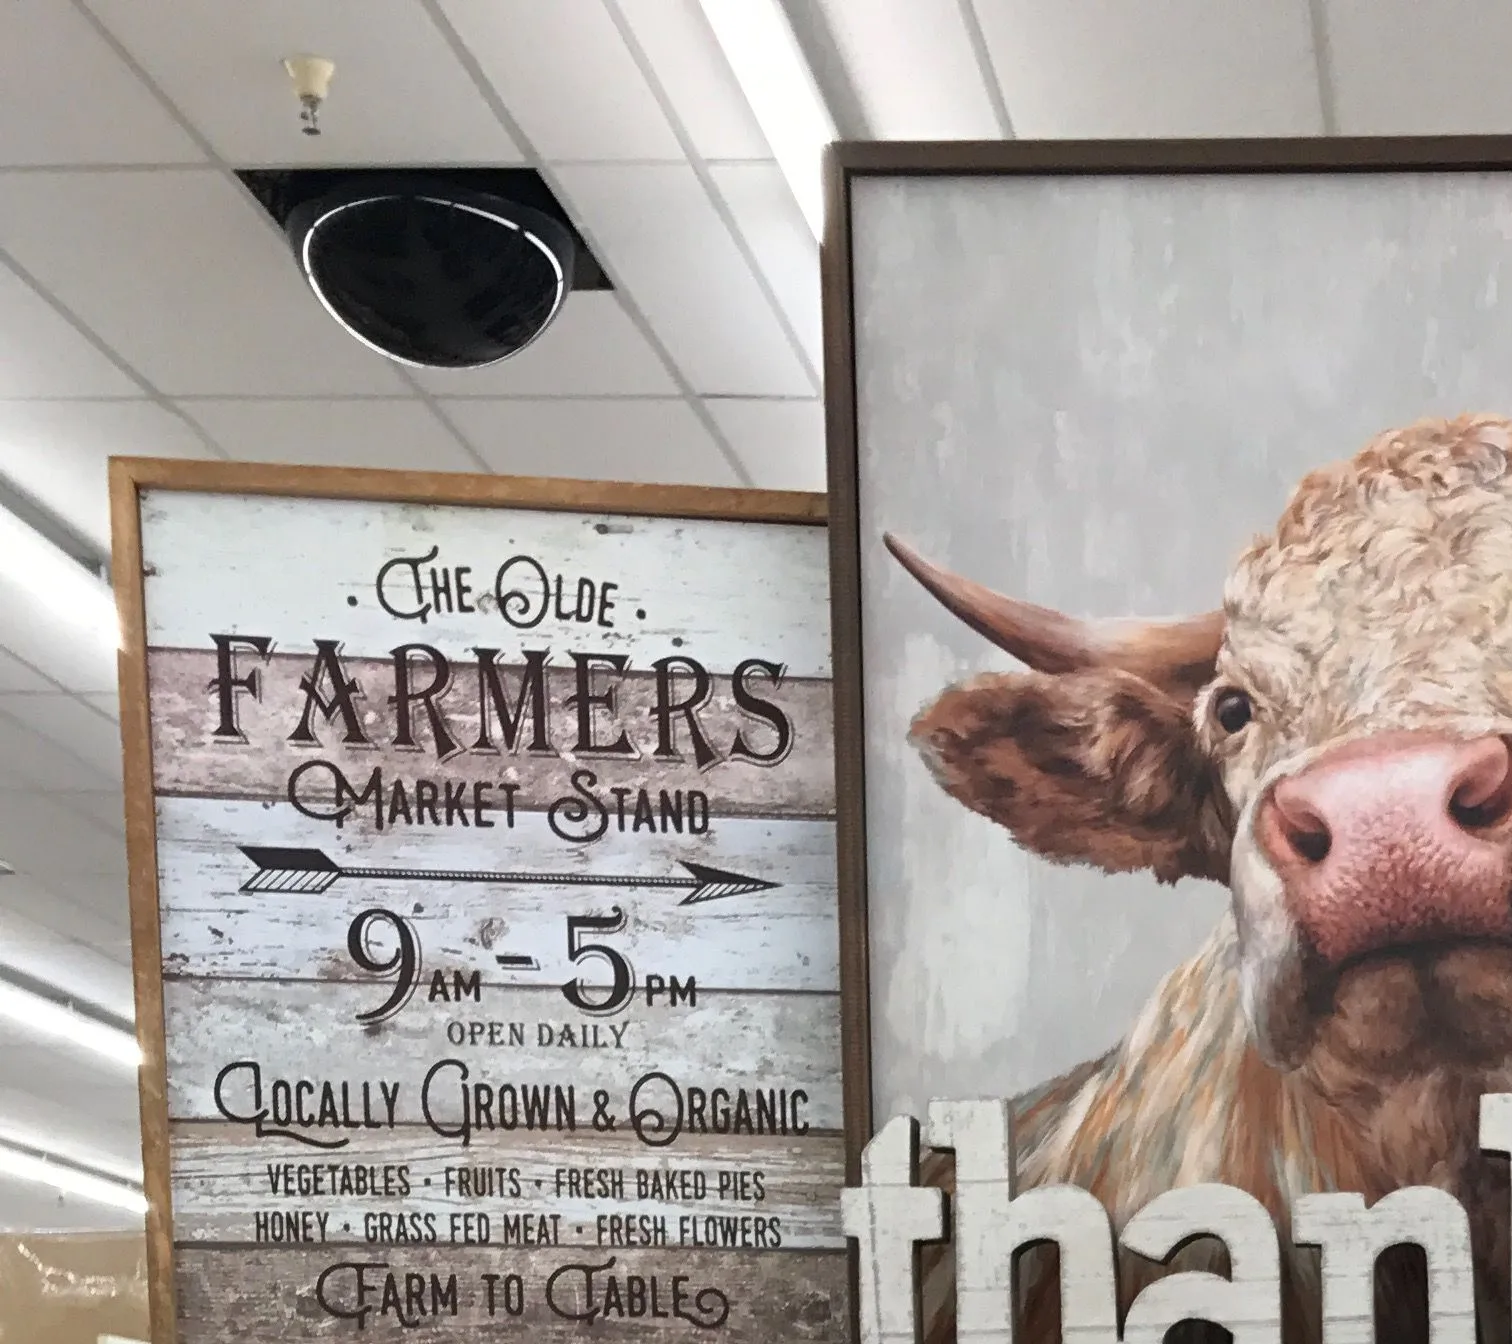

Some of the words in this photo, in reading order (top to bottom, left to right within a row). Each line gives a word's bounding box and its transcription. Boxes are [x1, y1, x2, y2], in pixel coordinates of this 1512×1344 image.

[208, 634, 795, 774] FARMERS
[288, 760, 521, 830] MARKET
[547, 769, 710, 842] STAND
[446, 1021, 526, 1047] OPEN
[536, 1021, 630, 1050] DAILY
[214, 1060, 400, 1149] LOCALLY
[421, 1058, 577, 1146] GROWN
[591, 1096, 617, 1132] &
[629, 1071, 811, 1147] ORGANIC
[266, 1163, 411, 1198] VEGETABLES
[444, 1166, 522, 1198] FRUITS
[555, 1168, 625, 1199] FRESH
[636, 1170, 707, 1201] BAKED
[718, 1172, 767, 1202] PIES
[255, 1214, 330, 1245] HONEY
[363, 1215, 437, 1245] GRASS
[449, 1215, 491, 1245] FED
[503, 1215, 562, 1247] MEAT
[597, 1215, 668, 1247] FRESH
[679, 1217, 783, 1250] FLOWERS
[316, 1261, 458, 1330] FARM
[482, 1274, 524, 1317] TO
[546, 1257, 730, 1329] TABLE
